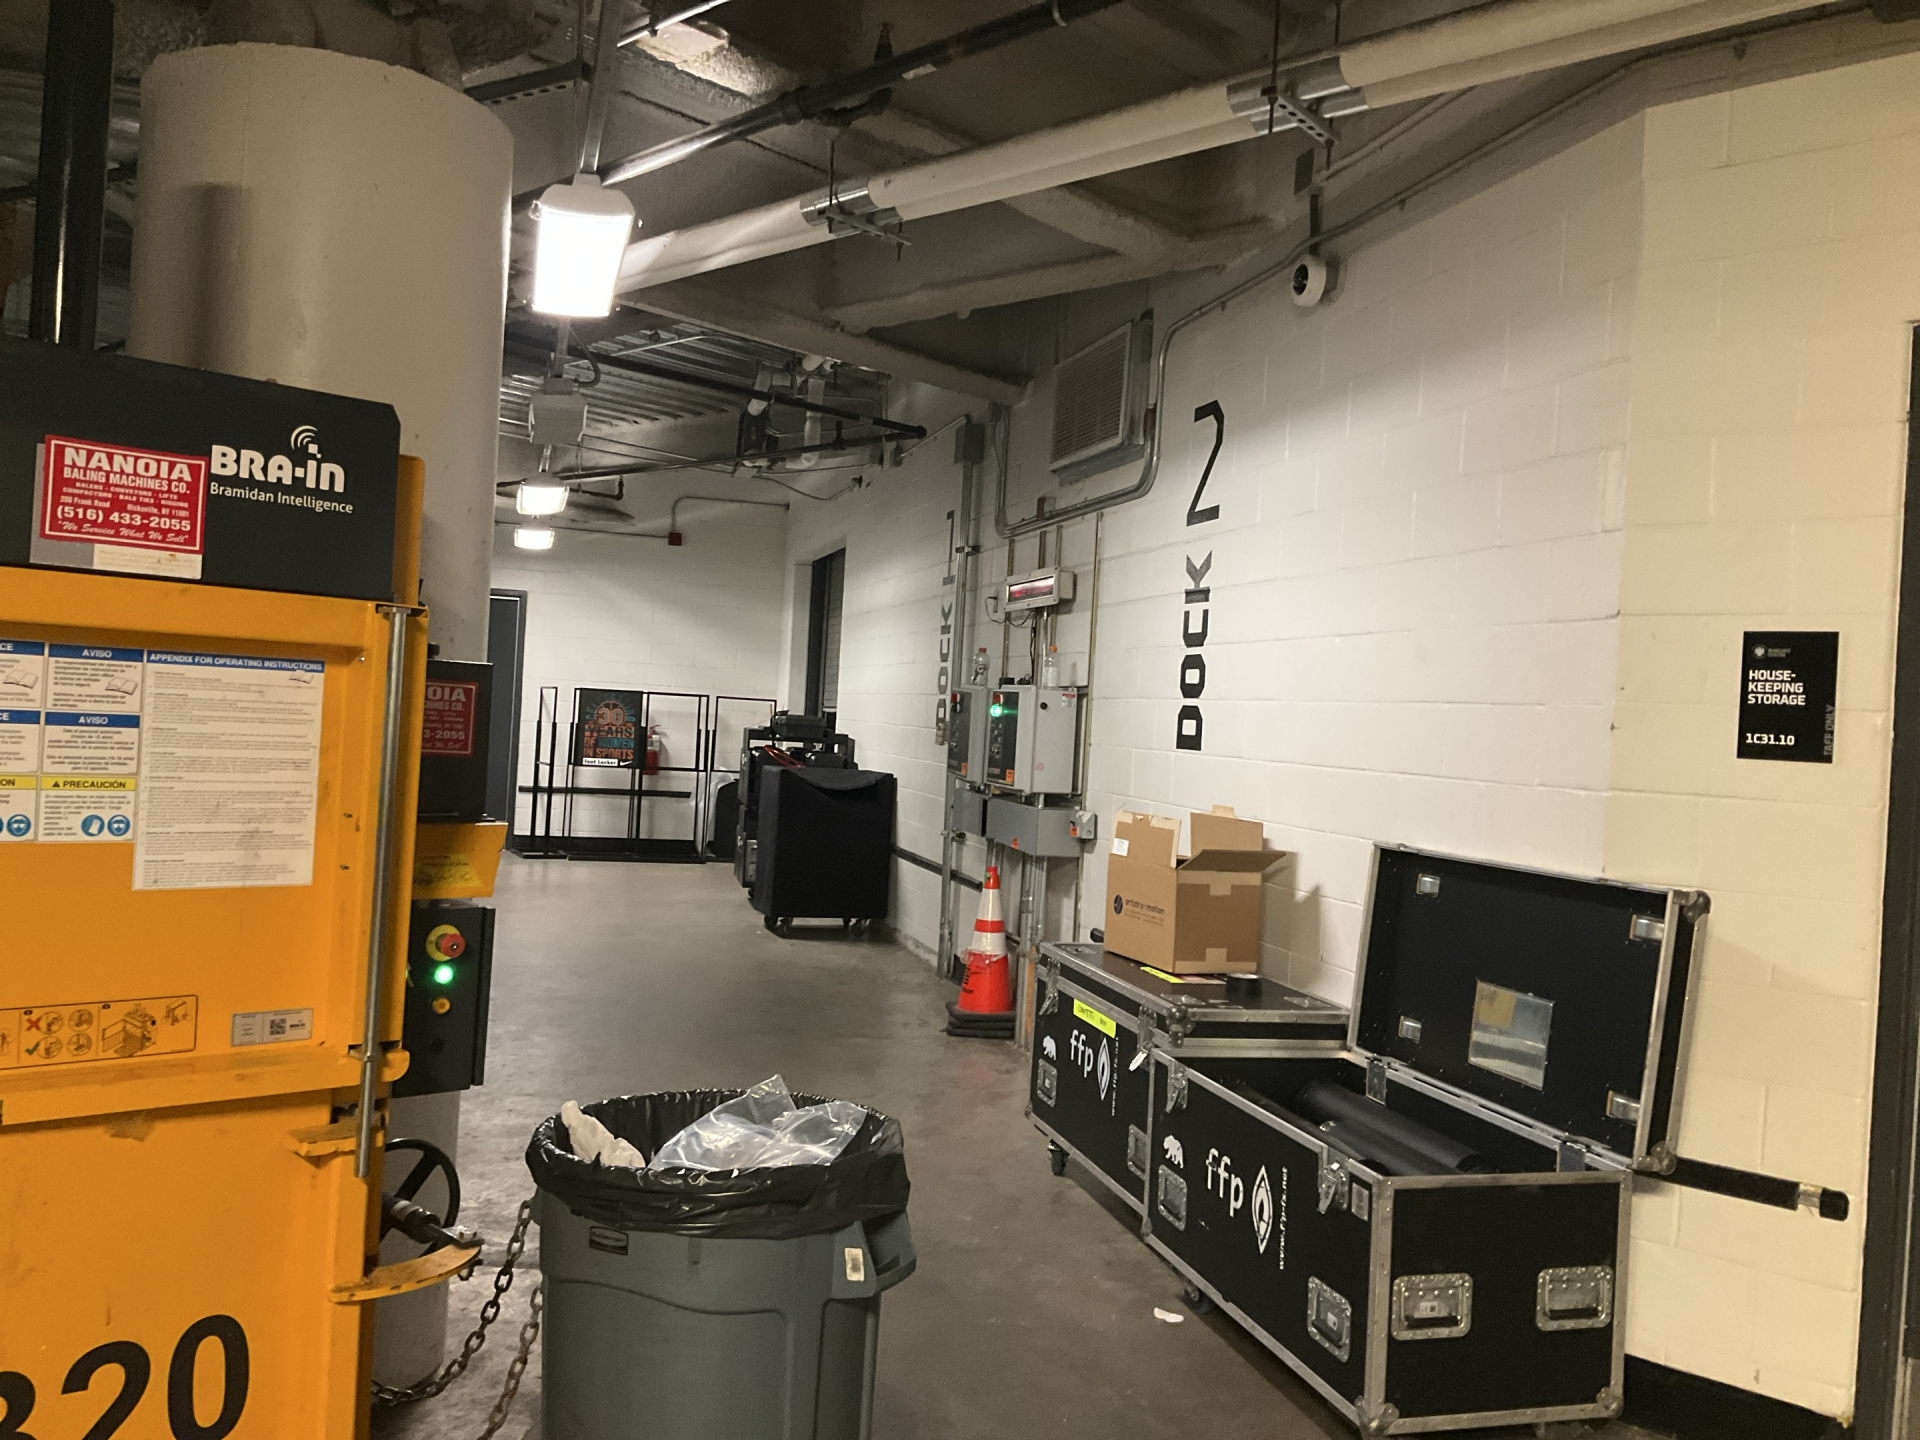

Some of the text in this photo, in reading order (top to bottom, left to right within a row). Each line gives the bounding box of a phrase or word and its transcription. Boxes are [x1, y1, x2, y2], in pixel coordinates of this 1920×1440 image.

[64, 447, 192, 482] NANOIA
[64, 467, 190, 494] BALING MACHINES CO.
[62, 487, 112, 499] COMPACTORS
[210, 482, 354, 514] Bramidan Intelligence
[57, 505, 191, 532] (516) 433-2055
[82, 524, 116, 536] Service
[120, 528, 145, 538] What
[149, 530, 163, 541] We
[1176, 400, 1225, 751] DOCK 2
[82, 648, 112, 658] AVISO
[150, 653, 322, 671] APPENDIX FOR OPERATING INSTRUCTIONS
[1748, 670, 1796, 681] HOUSE-
[1748, 682, 1804, 693] KEEPING
[1748, 694, 1806, 706] STORAGE
[78, 716, 108, 725] AVISO
[598, 708, 624, 726] 30
[1824, 704, 1835, 731] ONLY
[585, 724, 634, 738] YEARS
[584, 736, 596, 747] OF
[1746, 732, 1795, 746] 1C31.10
[596, 748, 634, 760] SPORTS
[62, 778, 126, 789] PRECAUCIÓN
[1070, 1029, 1094, 1078] ffp
[1206, 1148, 1244, 1218] ffp
